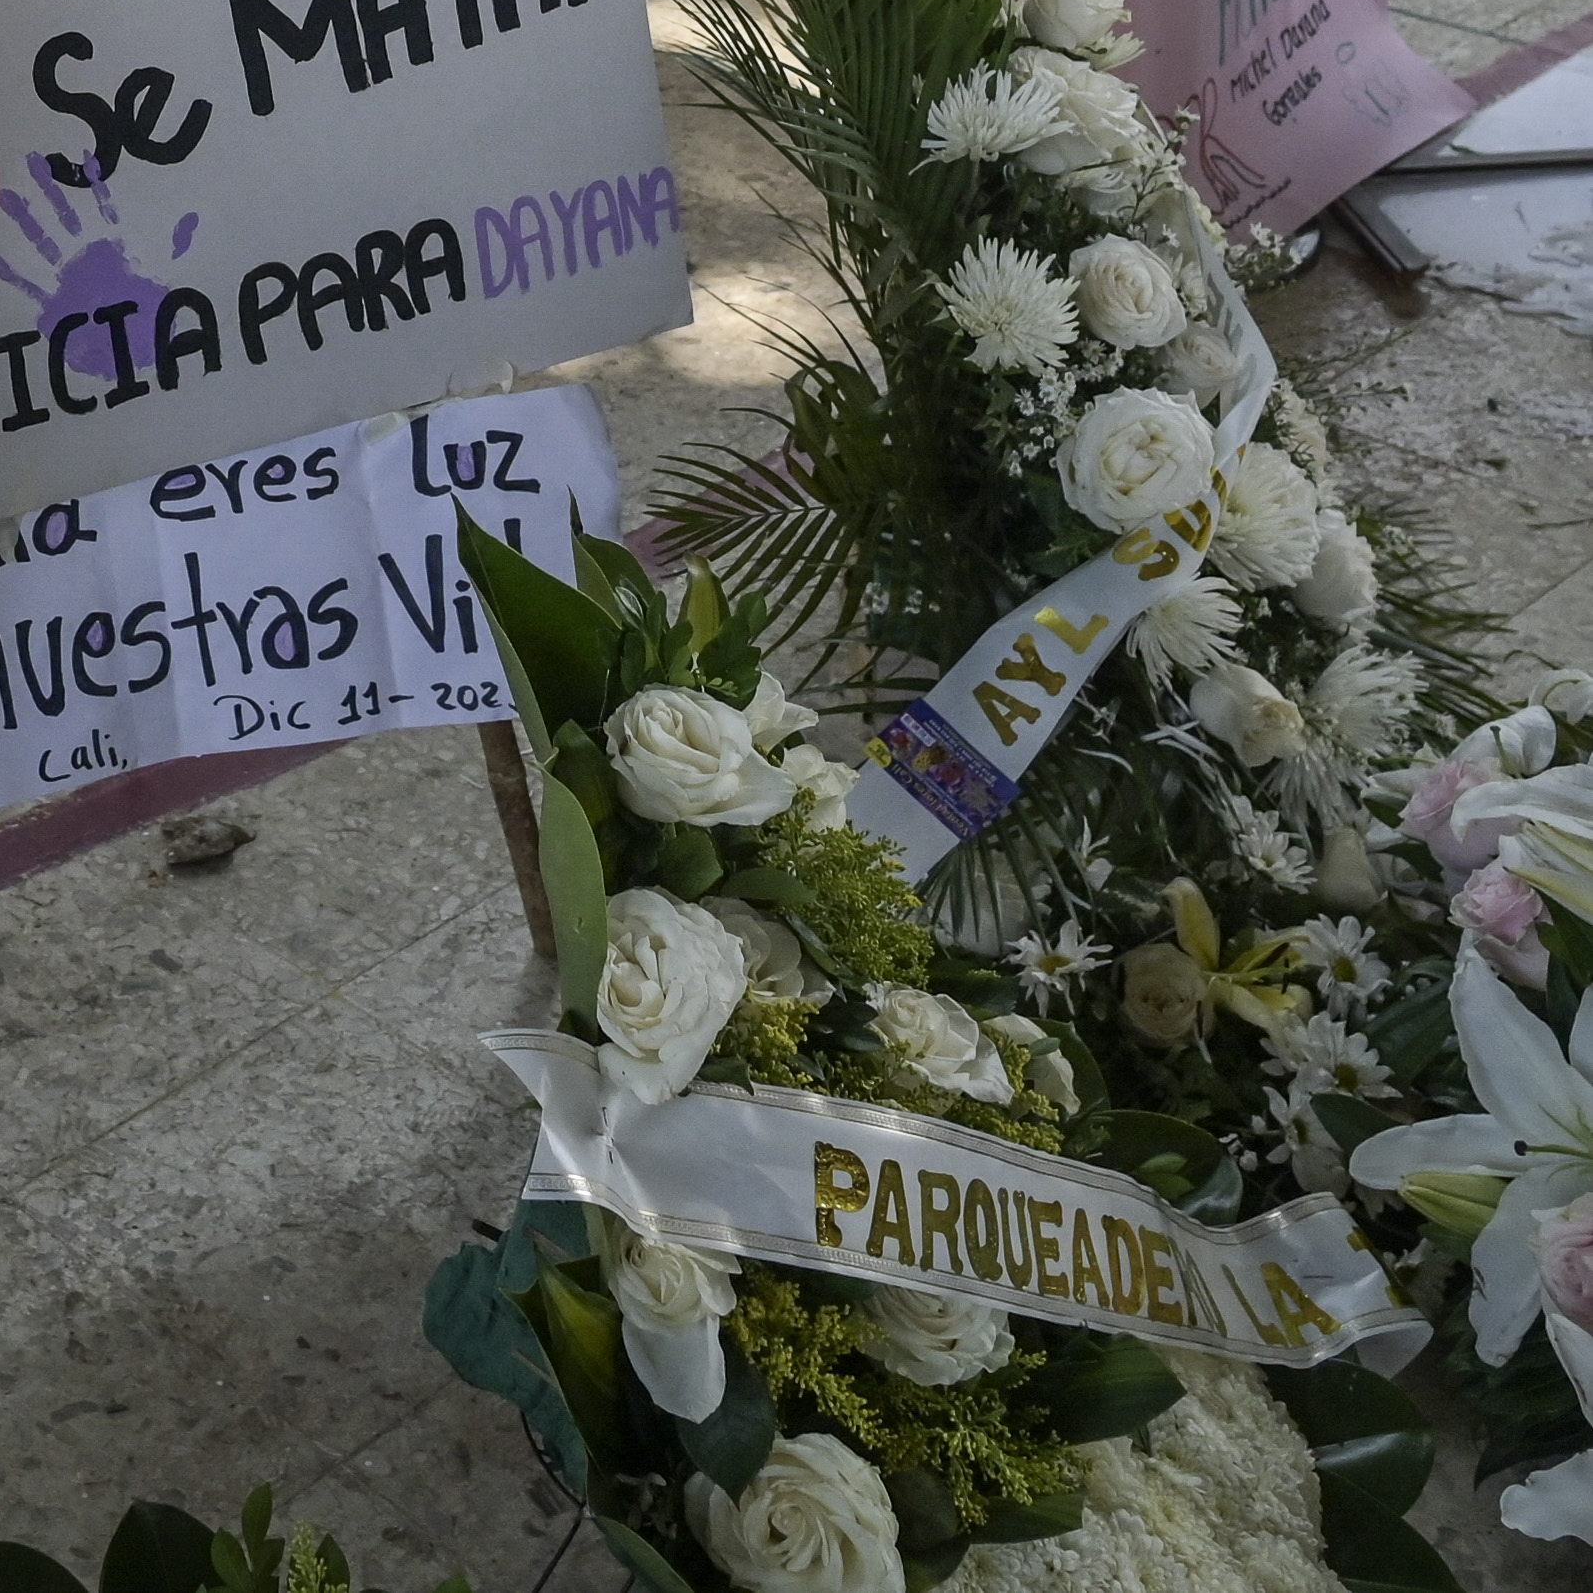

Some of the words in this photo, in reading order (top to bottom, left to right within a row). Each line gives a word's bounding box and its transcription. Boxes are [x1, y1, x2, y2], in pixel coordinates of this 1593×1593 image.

[239, 218, 466, 364] PARA
[473, 167, 682, 300] DAYANA
[149, 444, 341, 522] eres
[38, 728, 129, 783] Cali,
[212, 694, 310, 741] Dic
[1221, 1261, 1341, 1349] LA
